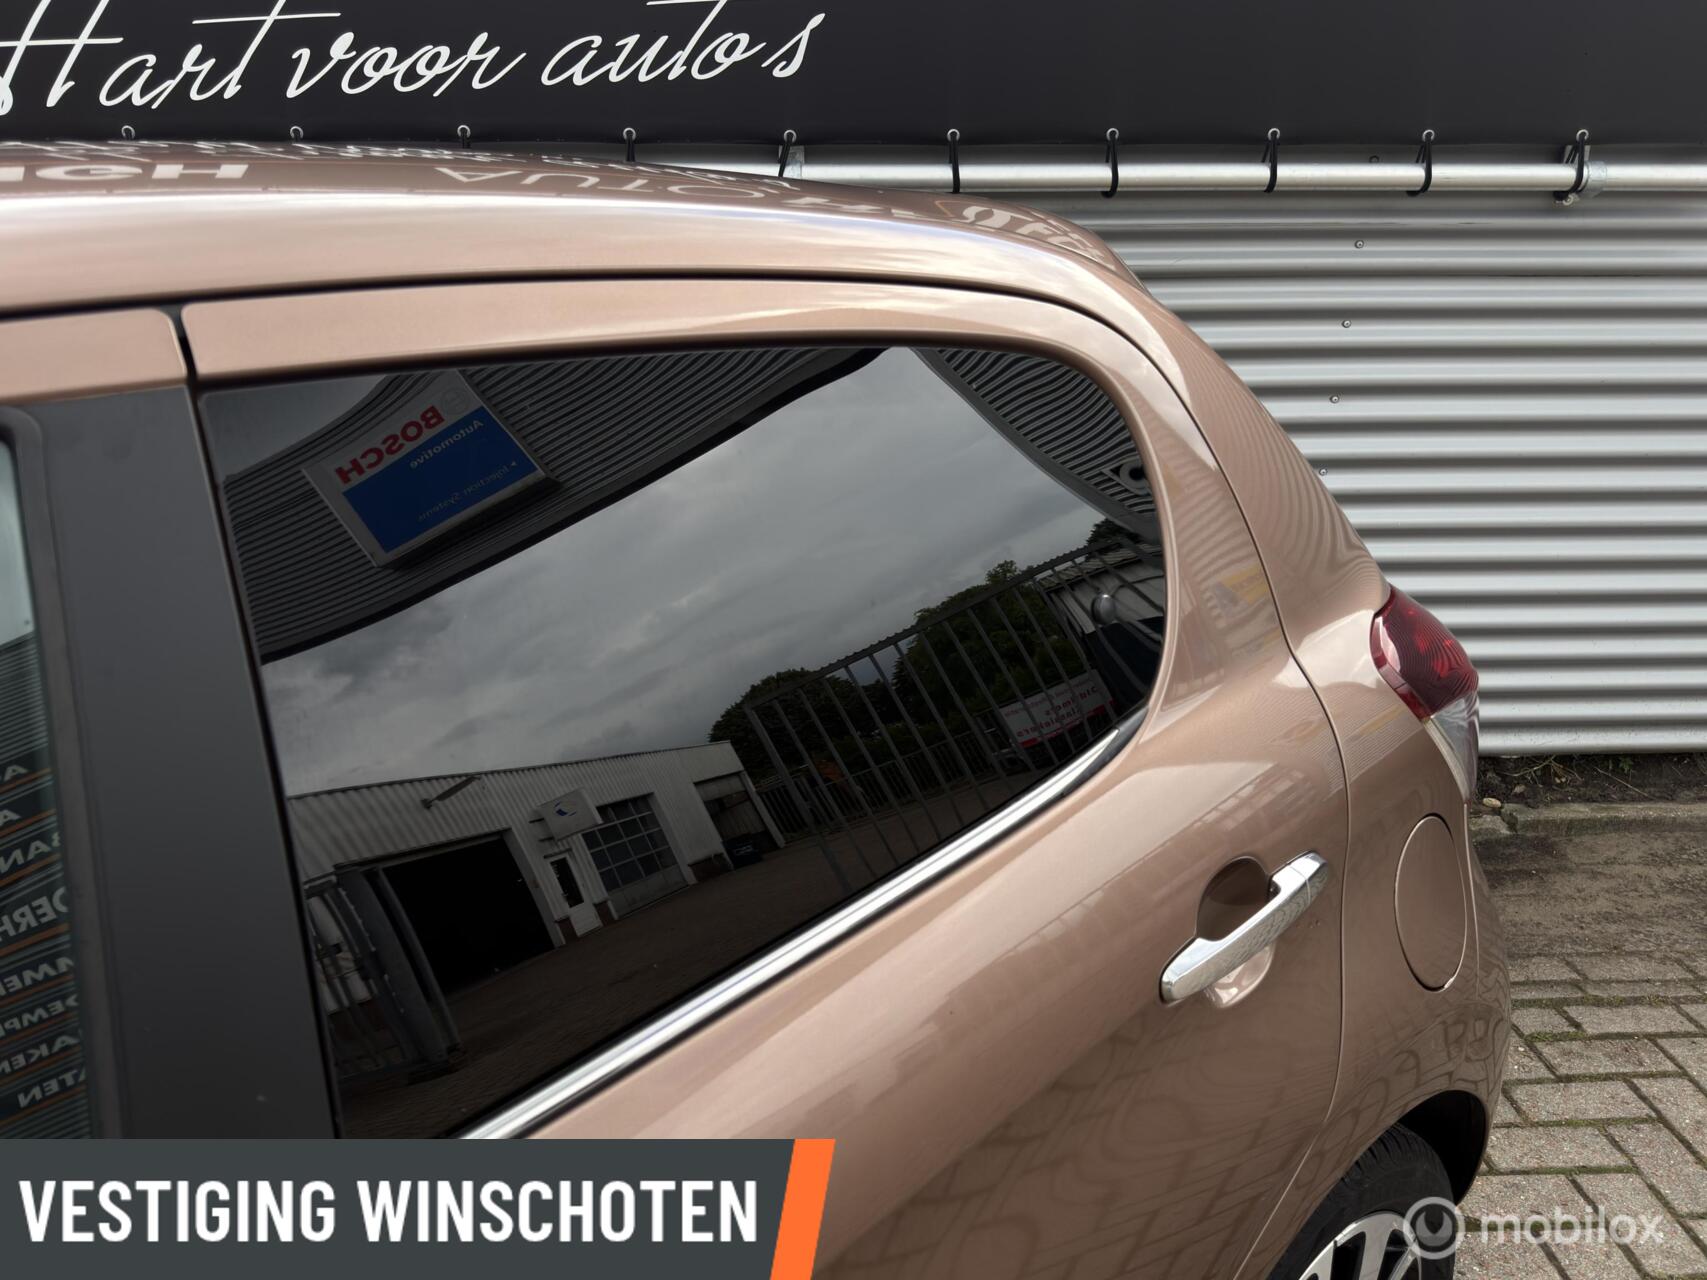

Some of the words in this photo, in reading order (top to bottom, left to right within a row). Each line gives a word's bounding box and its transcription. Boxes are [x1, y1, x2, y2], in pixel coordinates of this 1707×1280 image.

[0, 0, 341, 115] Hart
[292, 31, 527, 97] voor
[541, 0, 827, 89] autos
